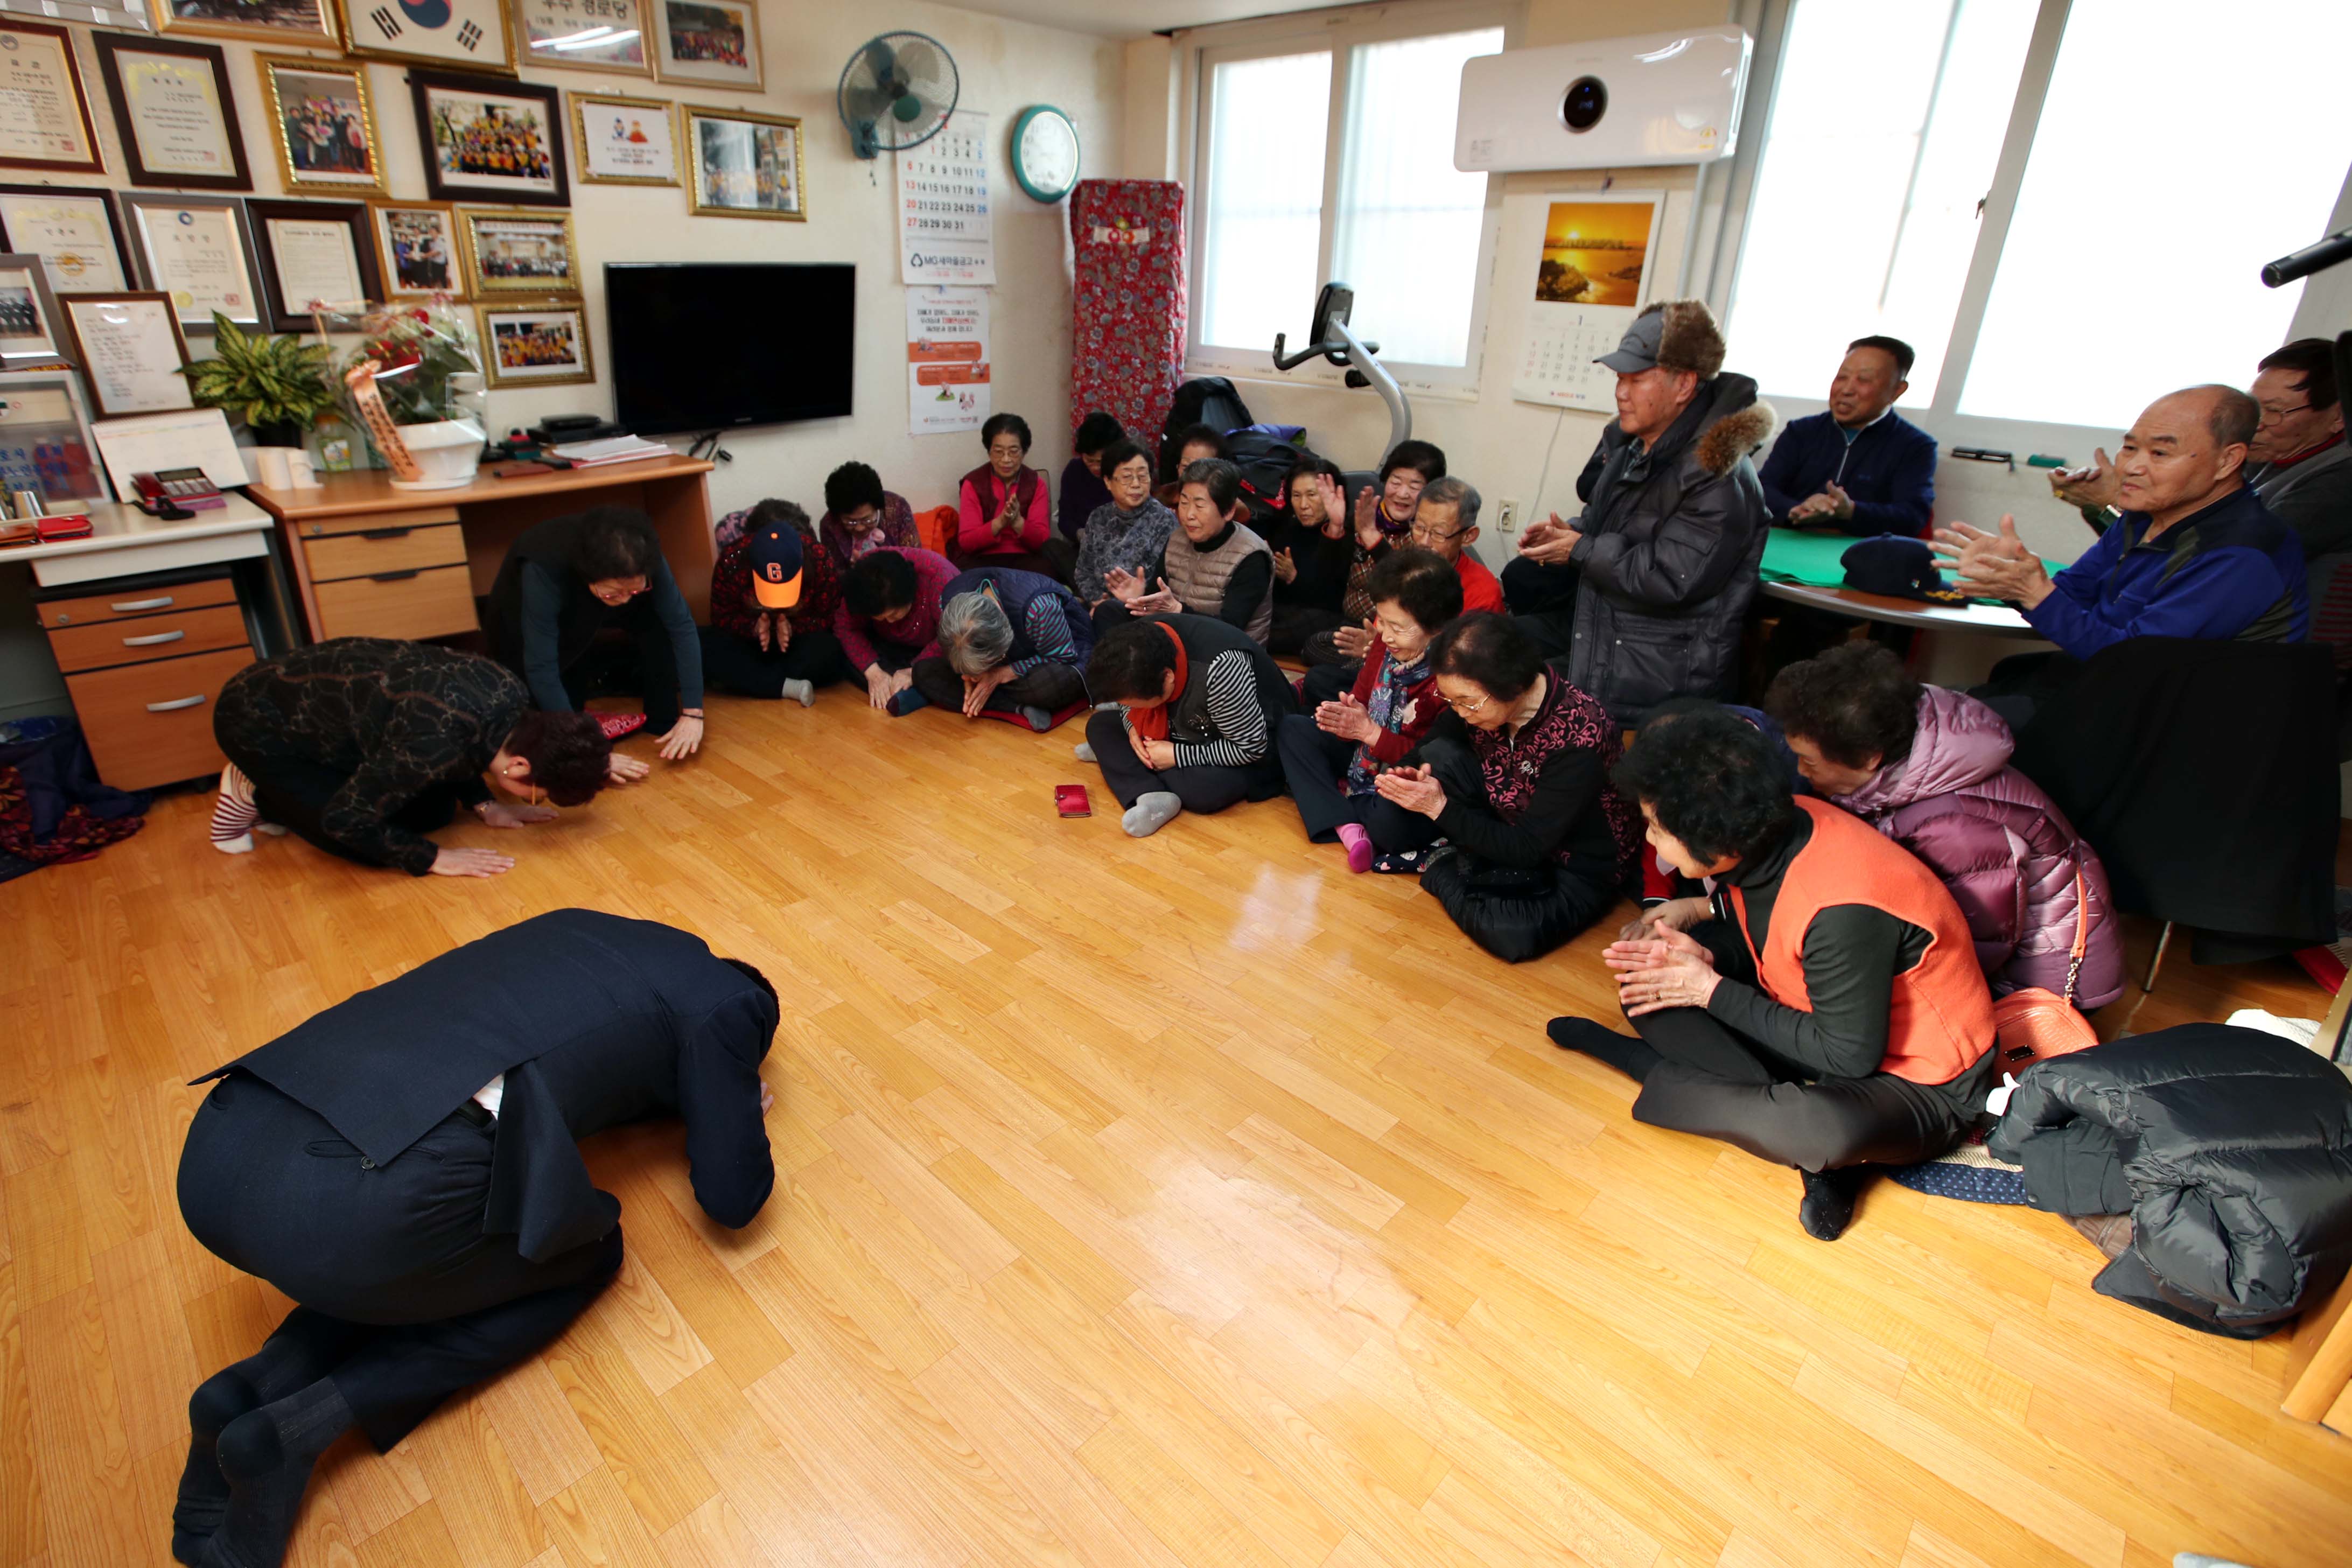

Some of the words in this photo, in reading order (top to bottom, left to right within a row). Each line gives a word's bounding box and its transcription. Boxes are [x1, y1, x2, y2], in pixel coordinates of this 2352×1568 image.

[931, 144, 935, 155] 1
[941, 146, 946, 156] 2
[954, 147, 958, 157] 3
[965, 149, 970, 158] 4
[977, 150, 982, 159] 5
[918, 163, 923, 172] 7
[930, 164, 935, 173] 8
[942, 165, 947, 174] 9
[952, 166, 962, 176] 10
[964, 167, 973, 176] 11
[976, 168, 985, 178] 12
[906, 180, 915, 190] 13
[918, 182, 926, 191] 14
[929, 183, 938, 192] 15
[941, 184, 950, 193] 16
[953, 185, 962, 194] 17
[964, 186, 974, 194] 18
[977, 186, 986, 195] 19
[906, 199, 916, 208] 20
[918, 200, 927, 209] 21
[929, 201, 939, 210] 22
[941, 202, 951, 211] 23
[954, 202, 963, 211] 24
[965, 204, 975, 212] 25
[977, 204, 987, 213] 26
[907, 217, 917, 226] 27
[919, 218, 928, 227] 28
[930, 219, 940, 228] 29
[942, 220, 952, 228] 30
[955, 220, 964, 229] 31
[1579, 315, 1583, 325] 1
[767, 563, 782, 582] G
